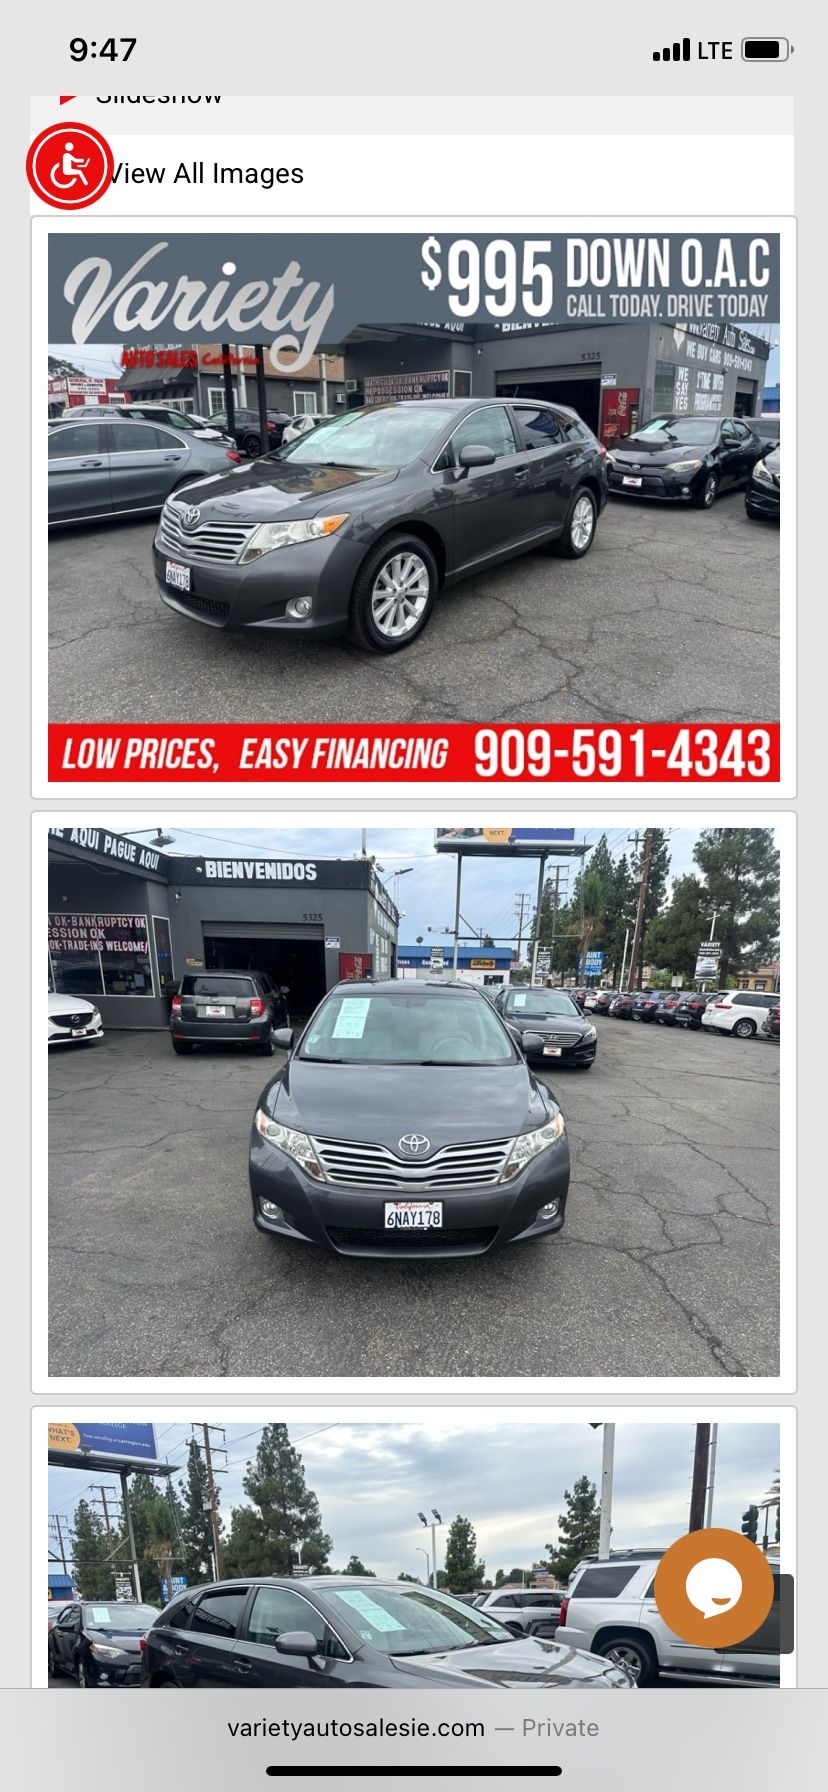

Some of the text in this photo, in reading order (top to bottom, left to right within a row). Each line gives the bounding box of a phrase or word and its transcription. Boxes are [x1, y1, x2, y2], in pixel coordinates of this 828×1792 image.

[69, 37, 137, 63] 9:47
[698, 41, 733, 60] LTE
[109, 161, 304, 189] View All Images
[580, 352, 601, 361] 5325
[686, 340, 697, 358] WE
[697, 343, 709, 362] BUY
[709, 346, 722, 364] CARS
[678, 366, 689, 381] WE
[414, 384, 423, 393] OK
[675, 381, 689, 396] SAY
[675, 396, 689, 410] YES
[69, 828, 100, 850] AQUI
[103, 834, 137, 863] PAGUE
[139, 849, 160, 870] AQUI
[205, 861, 317, 881] BIENVENIDOS
[134, 917, 146, 929] OK
[302, 913, 323, 922] 5325
[89, 928, 106, 939] OK
[105, 940, 148, 955] WELCOME!
[586, 951, 602, 959] AINT
[395, 1202, 432, 1211] California
[387, 1211, 440, 1227] 6NAY178
[50, 1434, 73, 1444] NEXT.
[228, 1717, 600, 1741] varietyautosalesie.com Private
